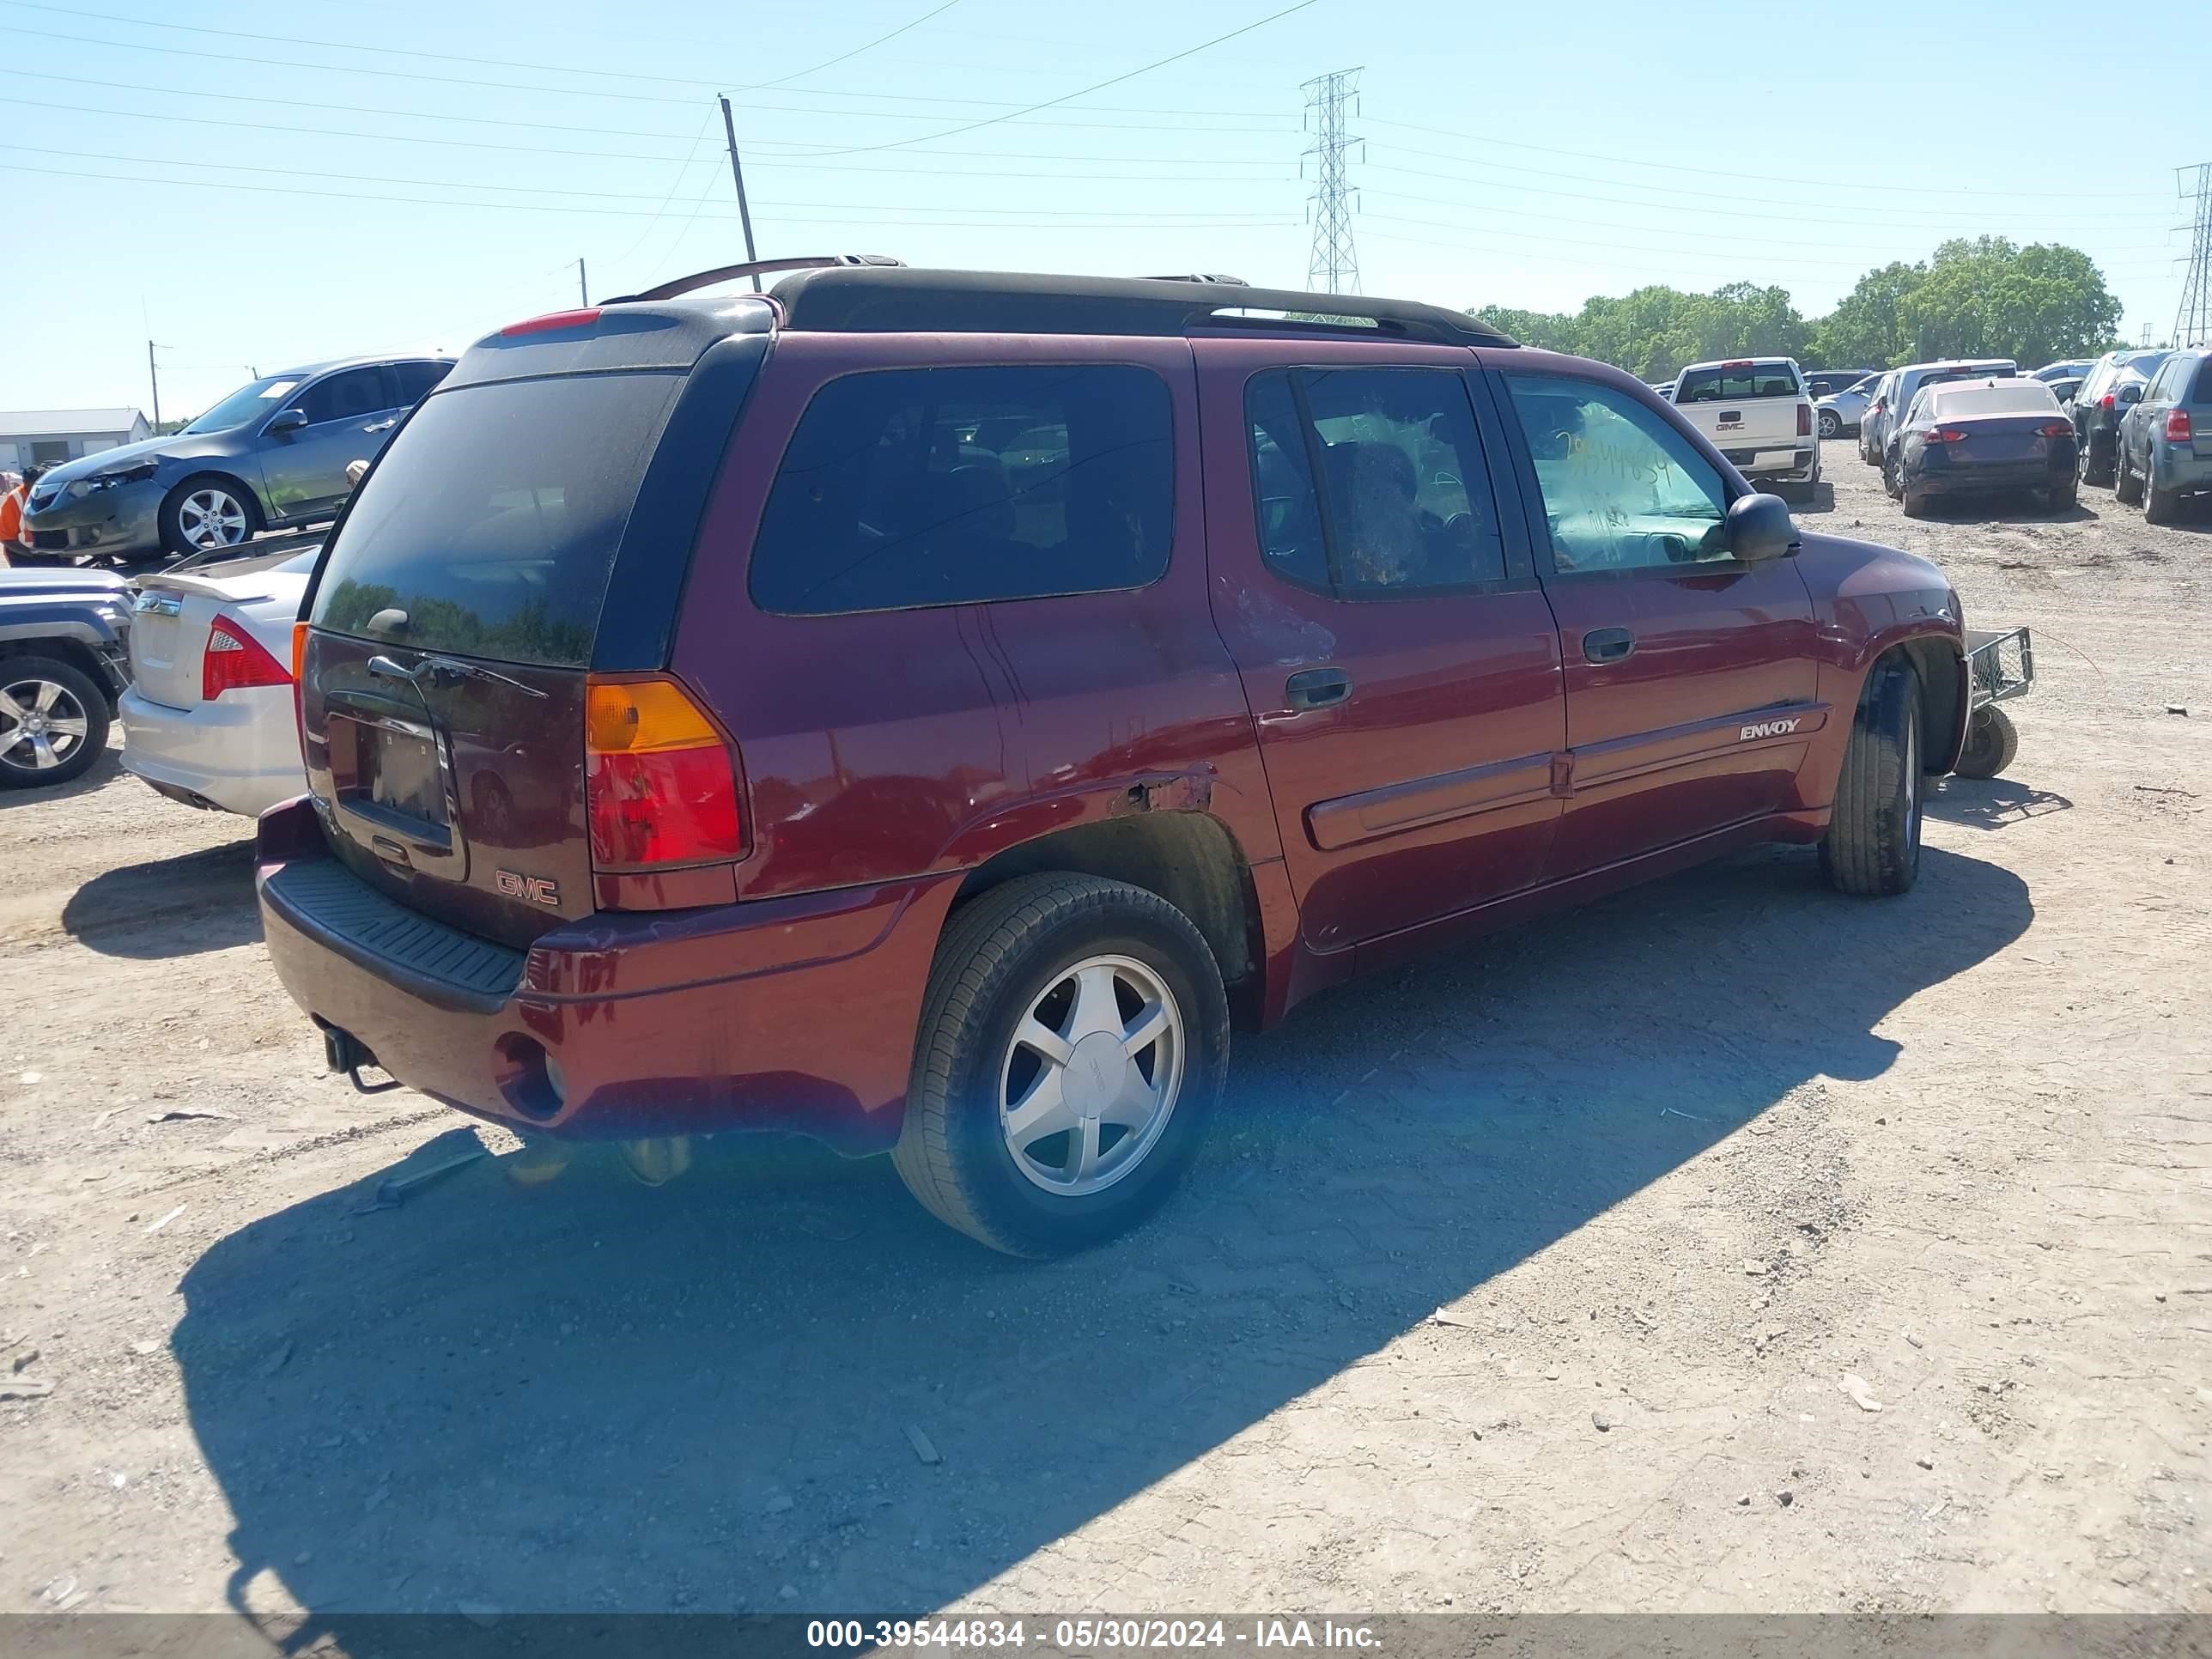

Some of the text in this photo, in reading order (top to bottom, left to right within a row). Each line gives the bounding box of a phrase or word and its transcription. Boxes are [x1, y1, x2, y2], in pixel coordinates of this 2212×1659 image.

[1716, 422, 1745, 432] GMC
[1740, 718, 1801, 741] ENVOY
[495, 870, 558, 905] GMC
